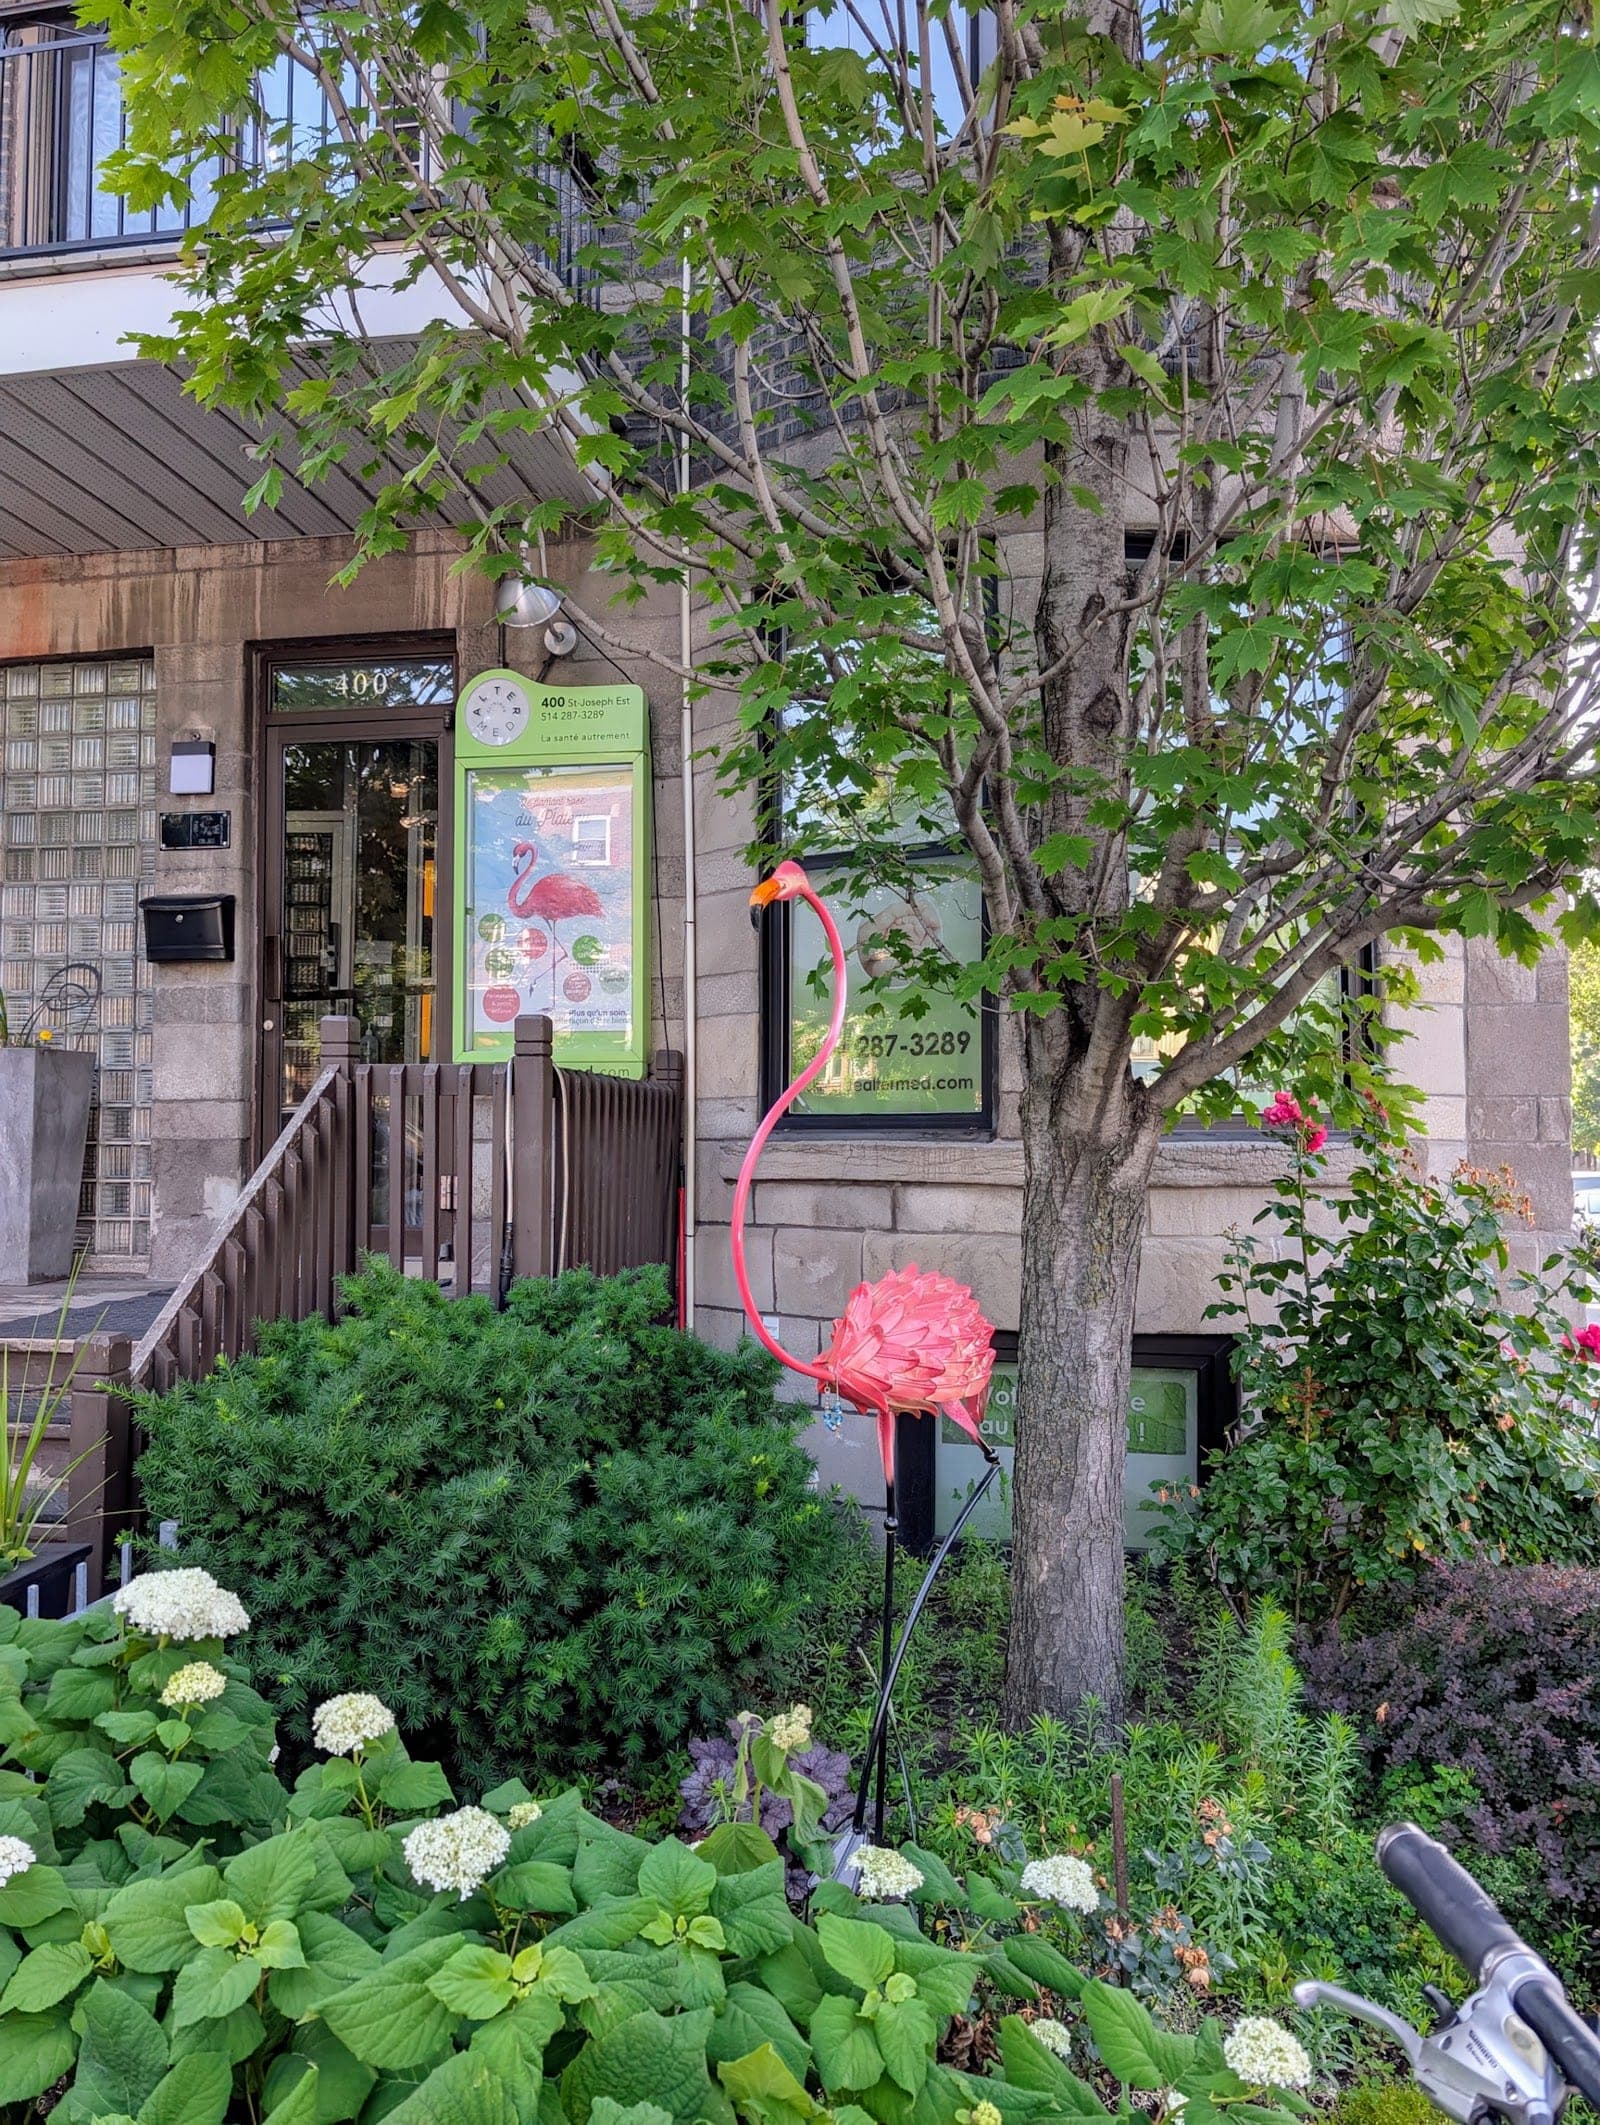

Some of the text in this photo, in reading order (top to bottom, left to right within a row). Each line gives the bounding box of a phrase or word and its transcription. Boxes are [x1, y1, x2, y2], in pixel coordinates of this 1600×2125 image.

[335, 673, 387, 695] 400
[541, 696, 630, 708] 400 St-Joseph Est
[541, 710, 605, 721] 514 287-3289
[541, 732, 630, 742] La santé autrement
[515, 812, 533, 827] du
[857, 1030, 971, 1058] 287-3289
[853, 1077, 973, 1092] ealtermed.com
[979, 1420, 1008, 1435] au
